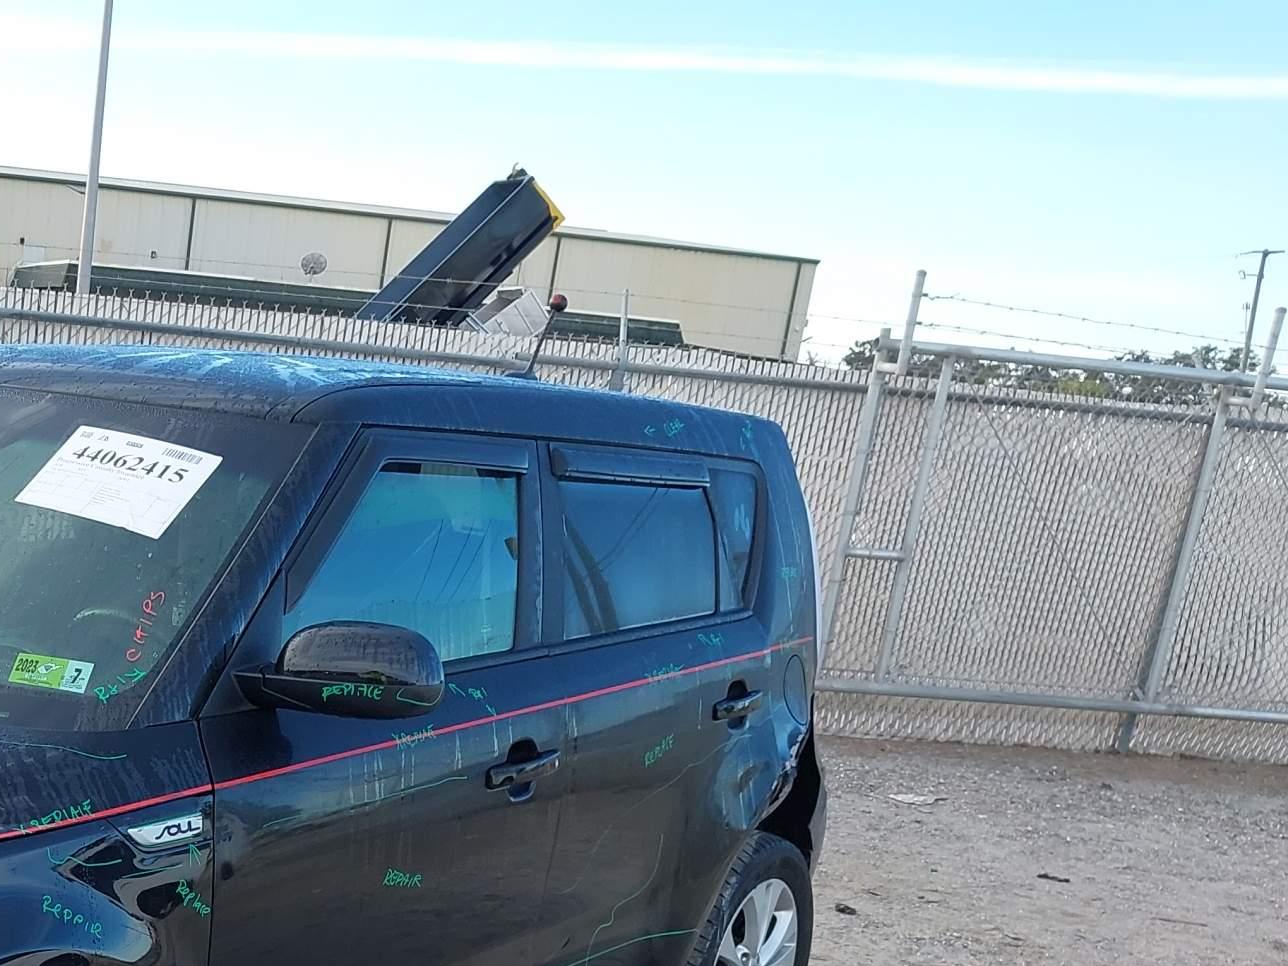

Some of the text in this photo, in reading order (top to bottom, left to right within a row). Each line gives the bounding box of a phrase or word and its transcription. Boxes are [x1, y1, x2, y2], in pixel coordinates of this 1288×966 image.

[72, 446, 189, 483] 44062415
[15, 658, 39, 673] 2023
[71, 668, 82, 684] 7
[155, 820, 201, 840] SOUL
